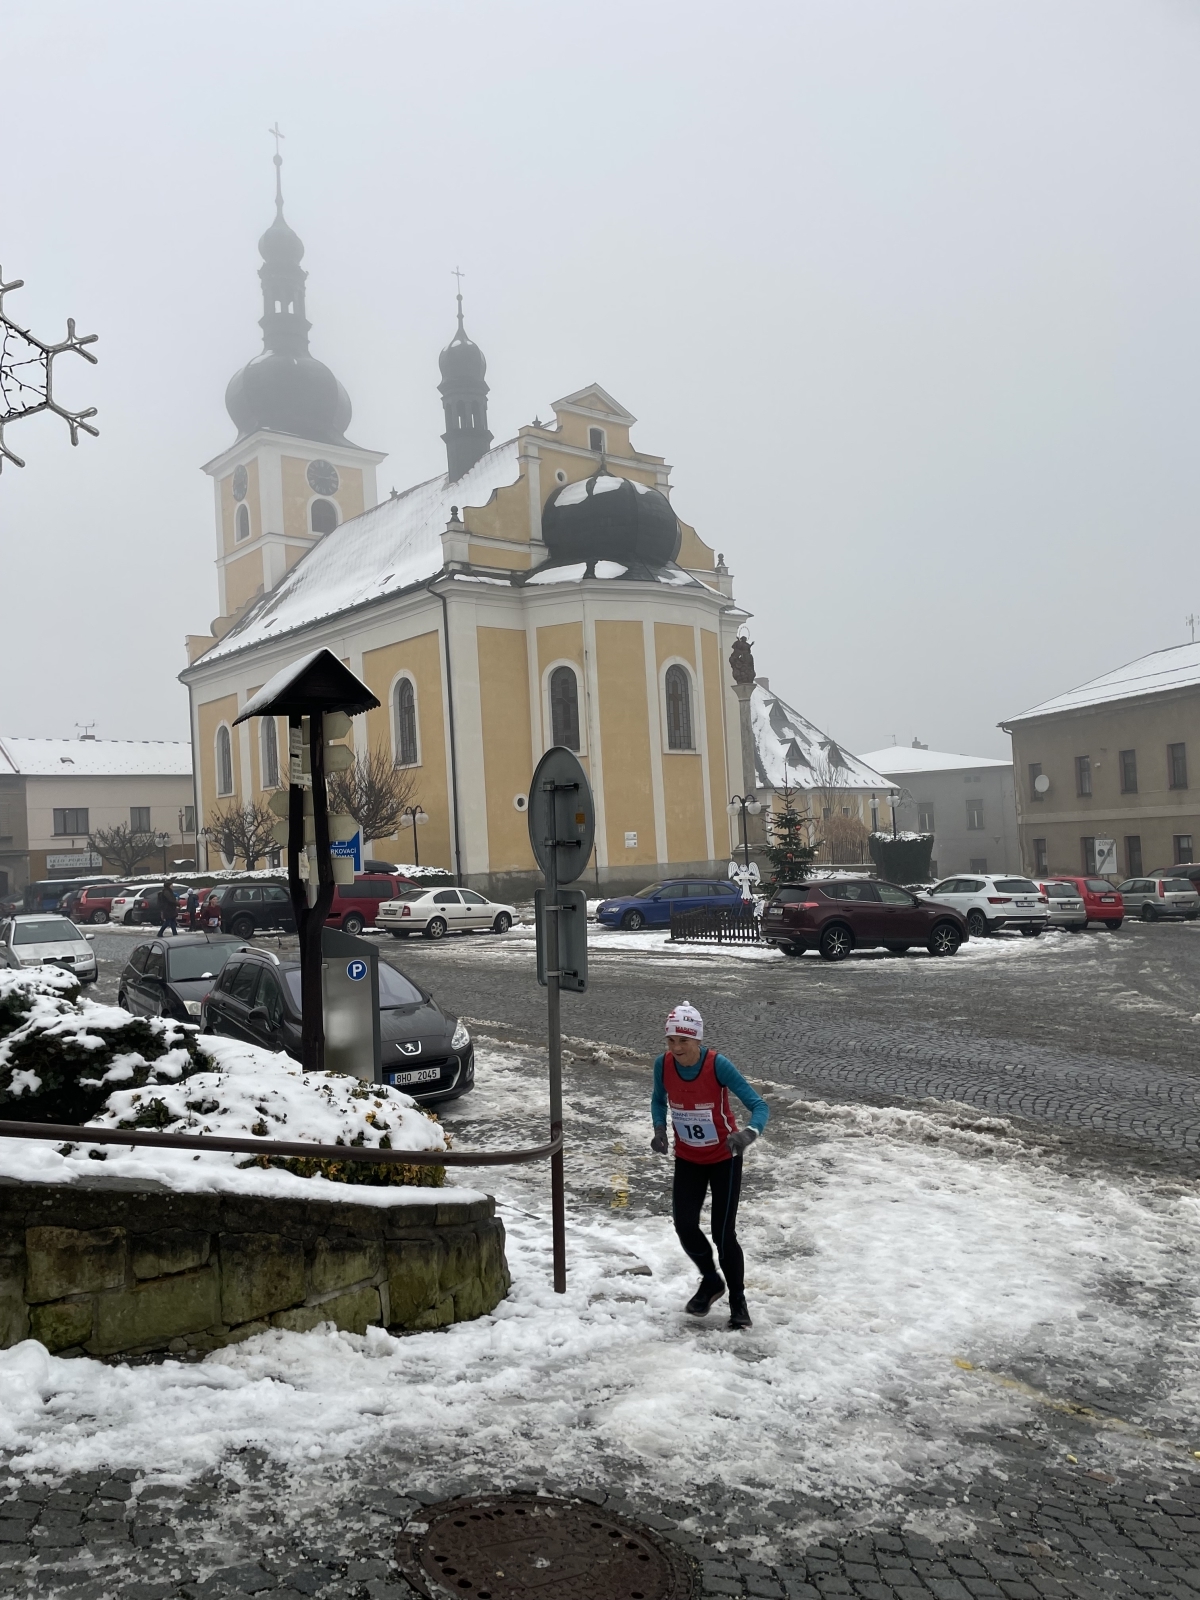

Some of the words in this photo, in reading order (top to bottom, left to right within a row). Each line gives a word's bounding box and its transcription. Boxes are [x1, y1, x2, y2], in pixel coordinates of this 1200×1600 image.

[330, 847, 357, 855] RKOVACÍ
[352, 963, 363, 978] P
[417, 1069, 437, 1081] 2045
[683, 1124, 706, 1140] 18
